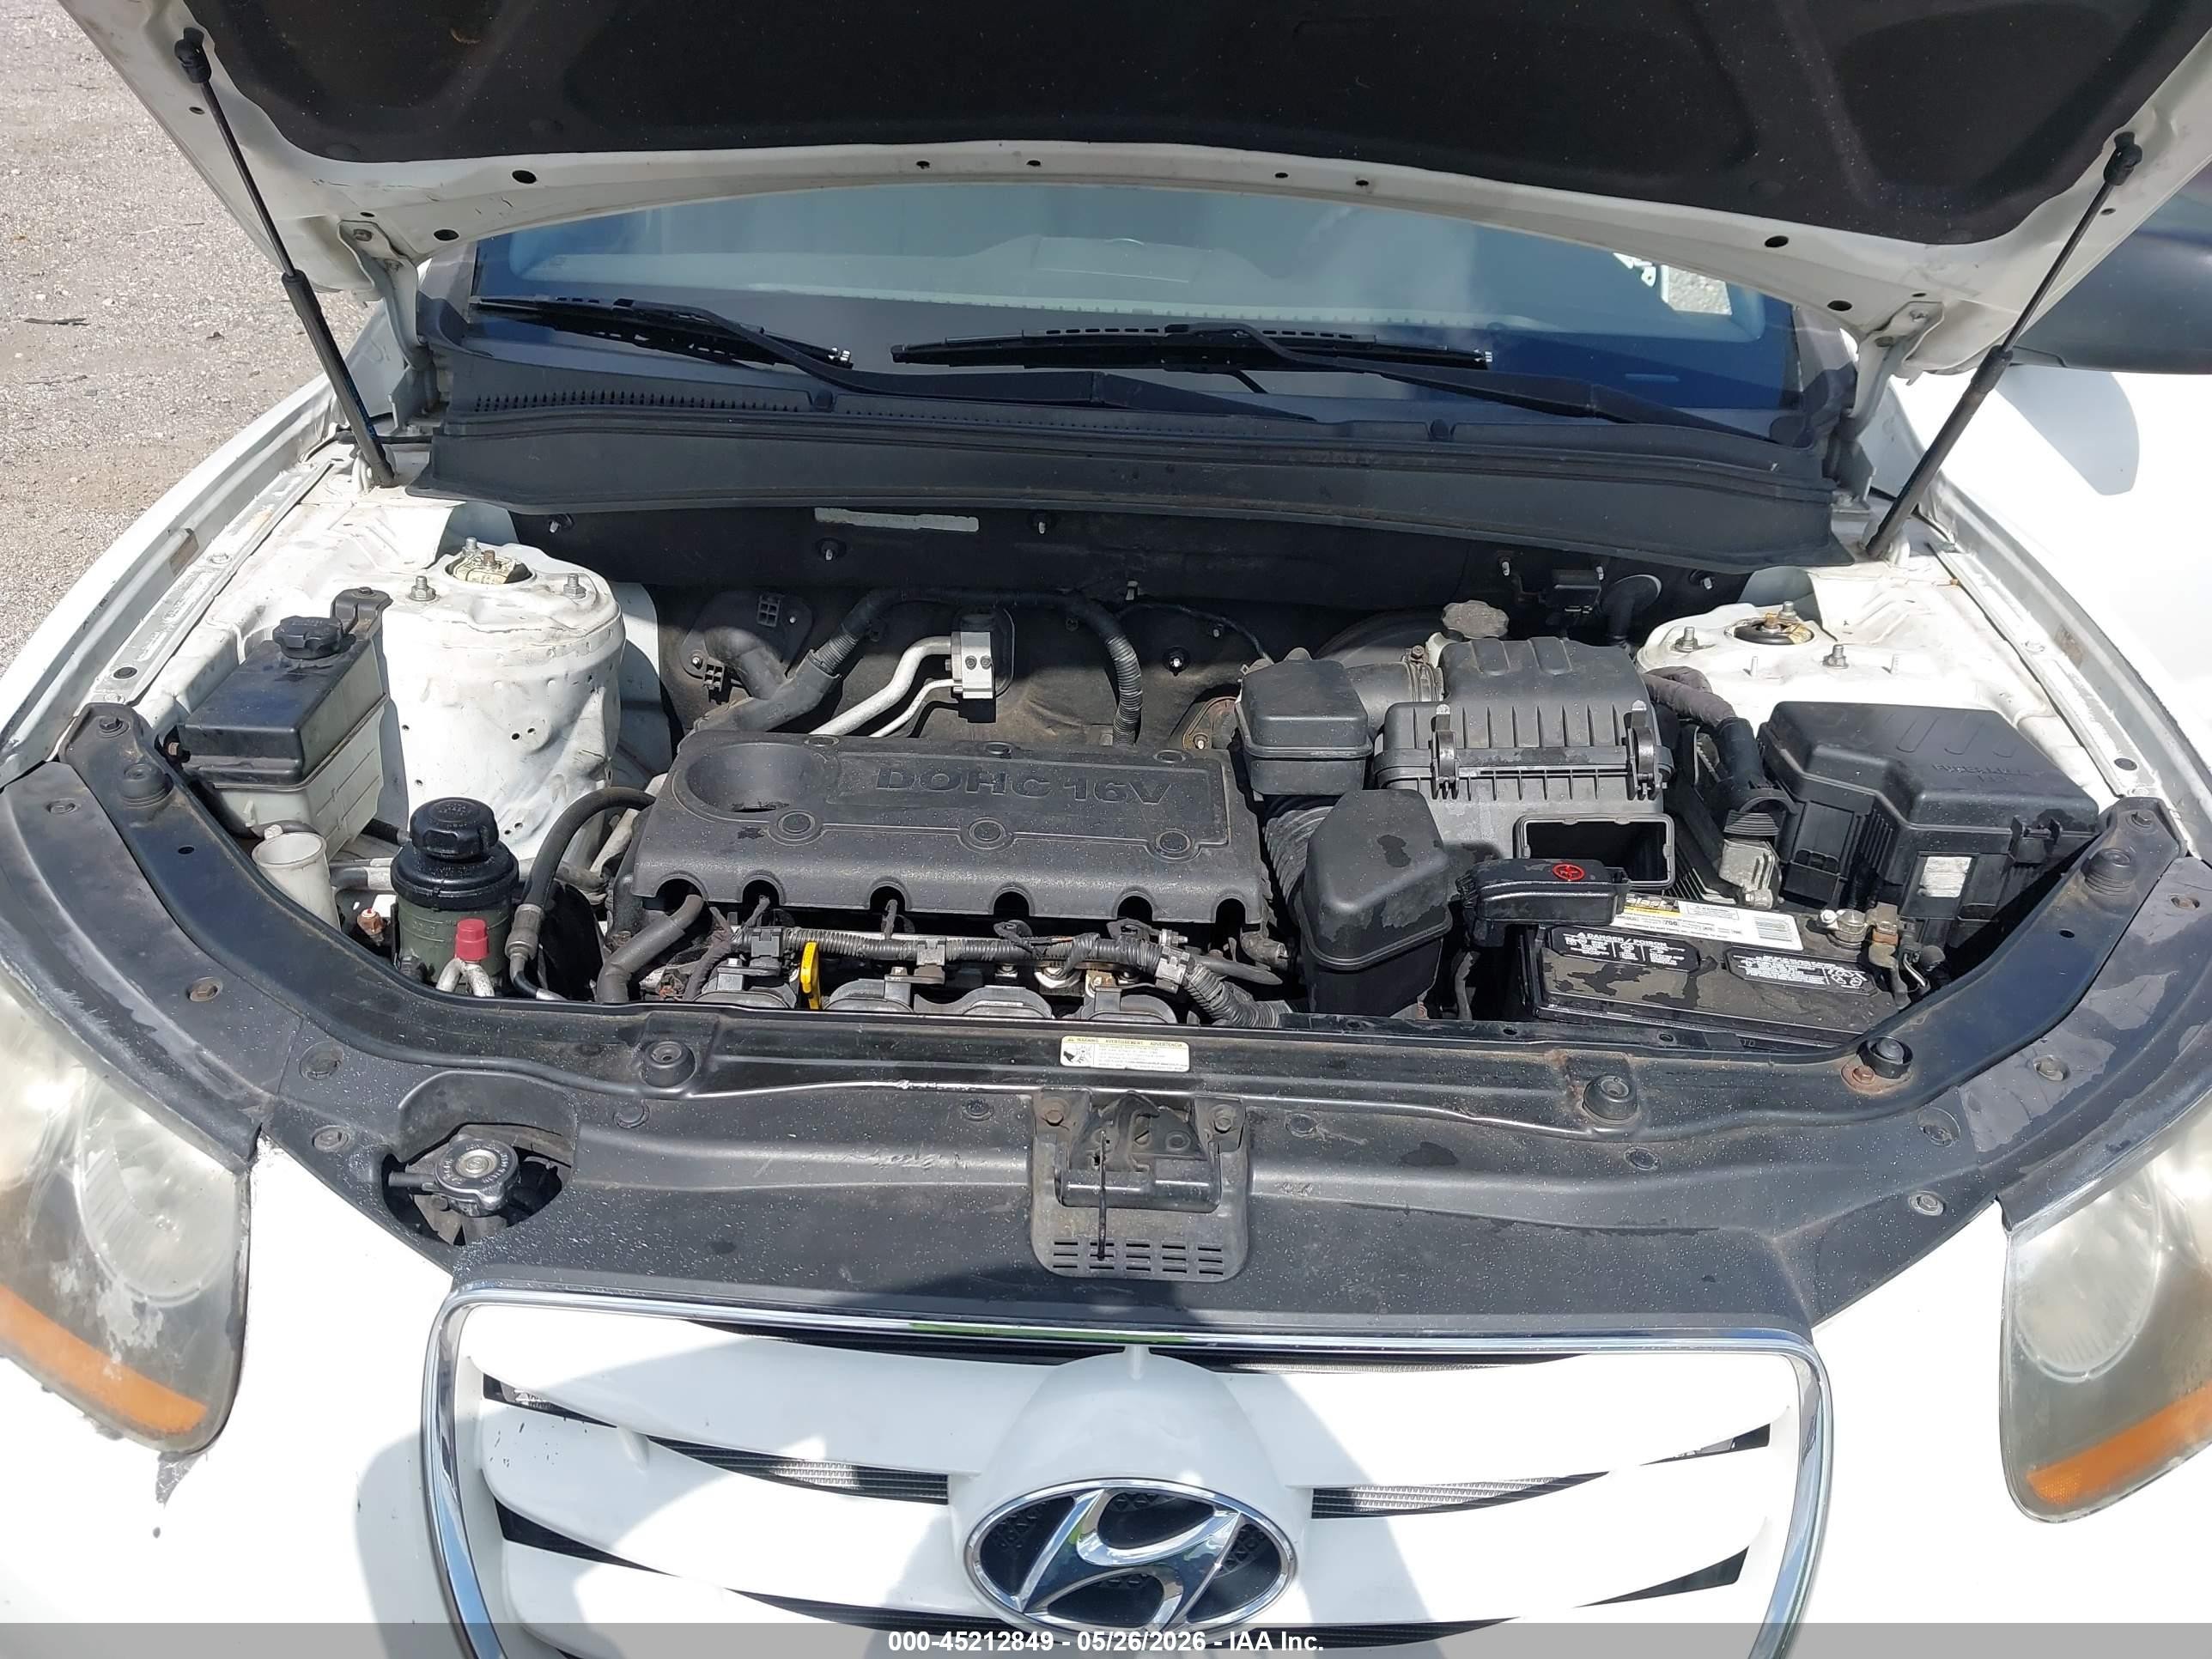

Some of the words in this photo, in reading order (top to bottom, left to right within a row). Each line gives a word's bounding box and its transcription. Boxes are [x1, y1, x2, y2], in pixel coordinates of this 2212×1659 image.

[876, 769, 1051, 798] DOHC
[1062, 777, 1171, 805] 16V
[1587, 933, 1624, 943] DANGER
[1633, 939, 1668, 947] POISON
